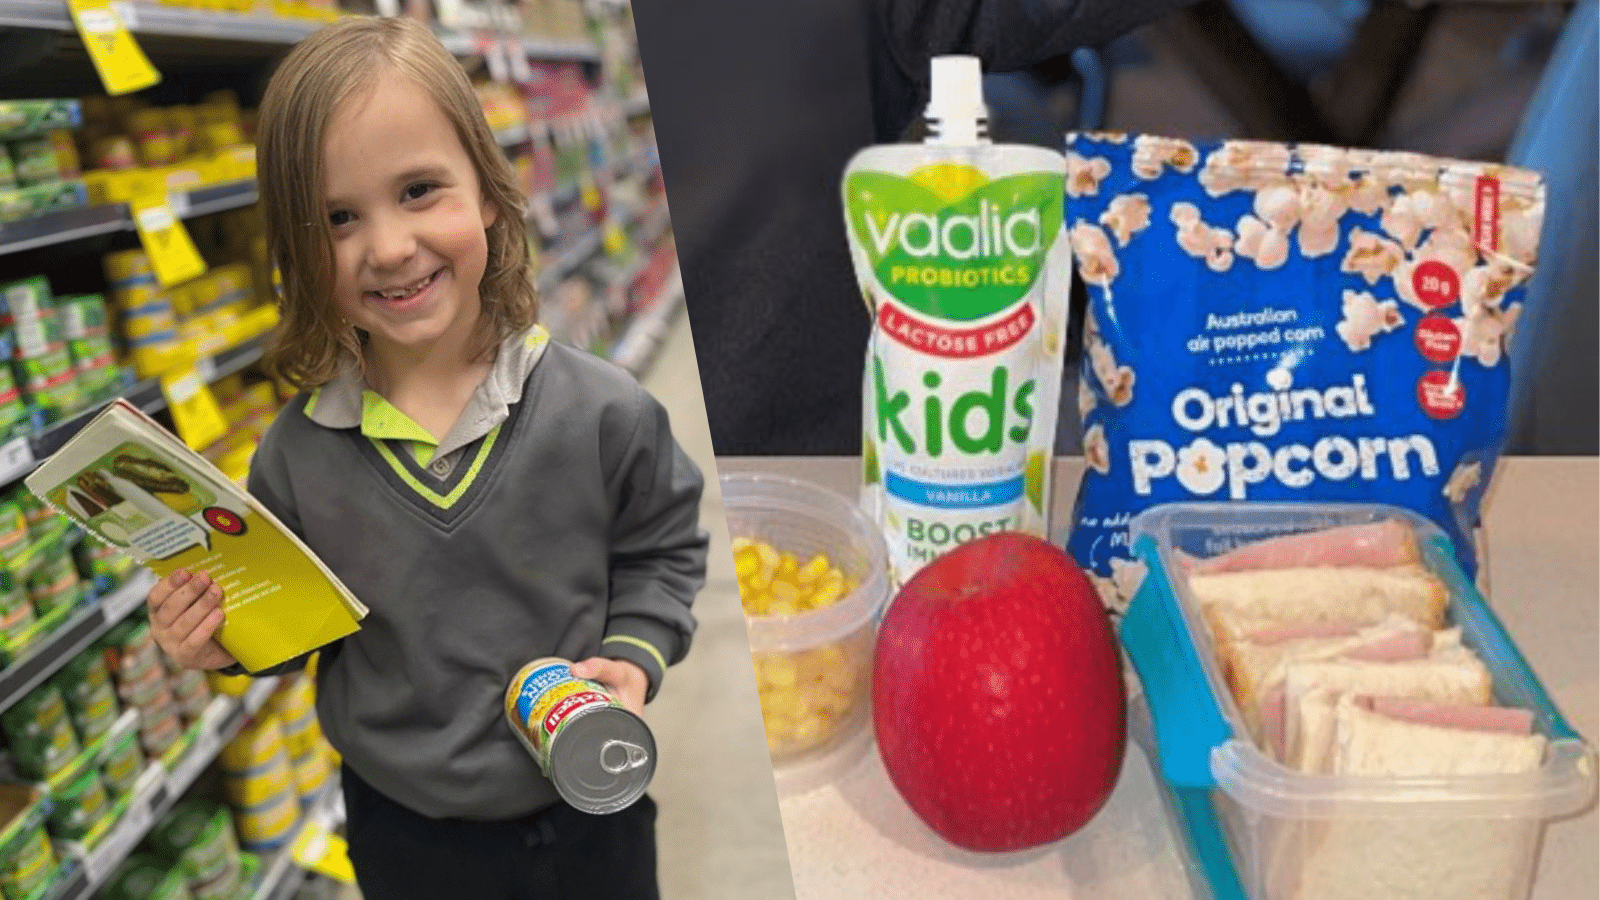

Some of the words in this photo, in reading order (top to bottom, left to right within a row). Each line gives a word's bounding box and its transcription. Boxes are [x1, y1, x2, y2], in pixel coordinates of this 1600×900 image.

[864, 199, 1041, 259] vaalia
[891, 265, 1030, 287] PROBIOTICS
[885, 314, 979, 352] LACTOSE
[983, 312, 1029, 349] FREE
[1206, 306, 1299, 331] Australian
[1187, 333, 1210, 352] air
[1213, 326, 1281, 355] popped
[1283, 326, 1326, 342] corn
[873, 355, 1036, 457] kids
[1172, 372, 1375, 436] Original
[925, 490, 992, 502] VANILLA
